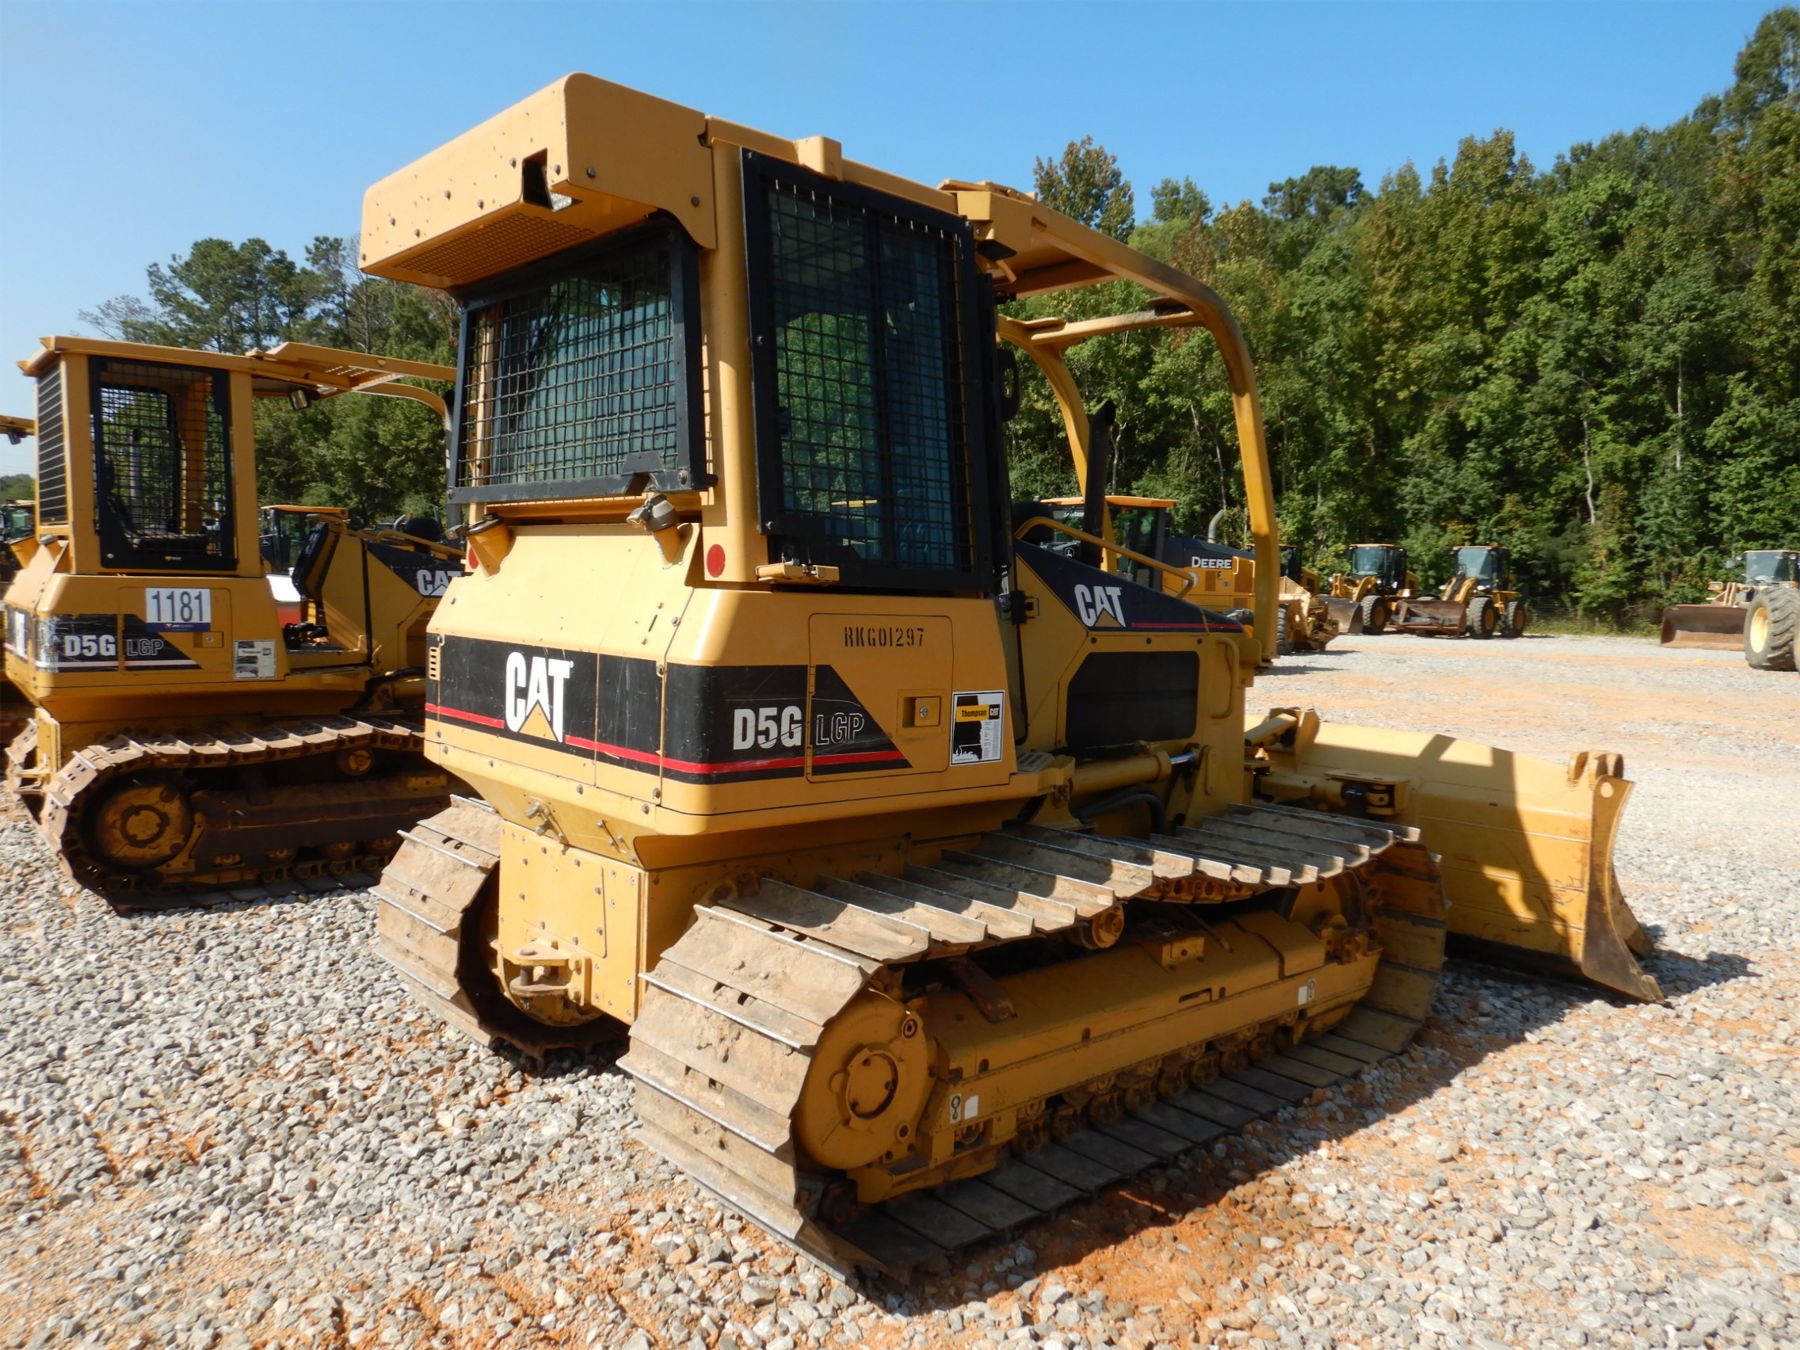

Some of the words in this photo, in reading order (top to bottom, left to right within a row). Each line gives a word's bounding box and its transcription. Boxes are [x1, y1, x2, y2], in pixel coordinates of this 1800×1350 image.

[1191, 556, 1232, 569] DEERE
[152, 591, 203, 622] 1181
[1074, 584, 1126, 628] CAT
[64, 633, 117, 657] D5G
[128, 638, 165, 657] LGP
[844, 625, 925, 648] RKG01297
[506, 651, 573, 743] CAT
[961, 709, 988, 718] Thompson
[733, 705, 802, 751] D5G
[816, 712, 865, 746] LGP
